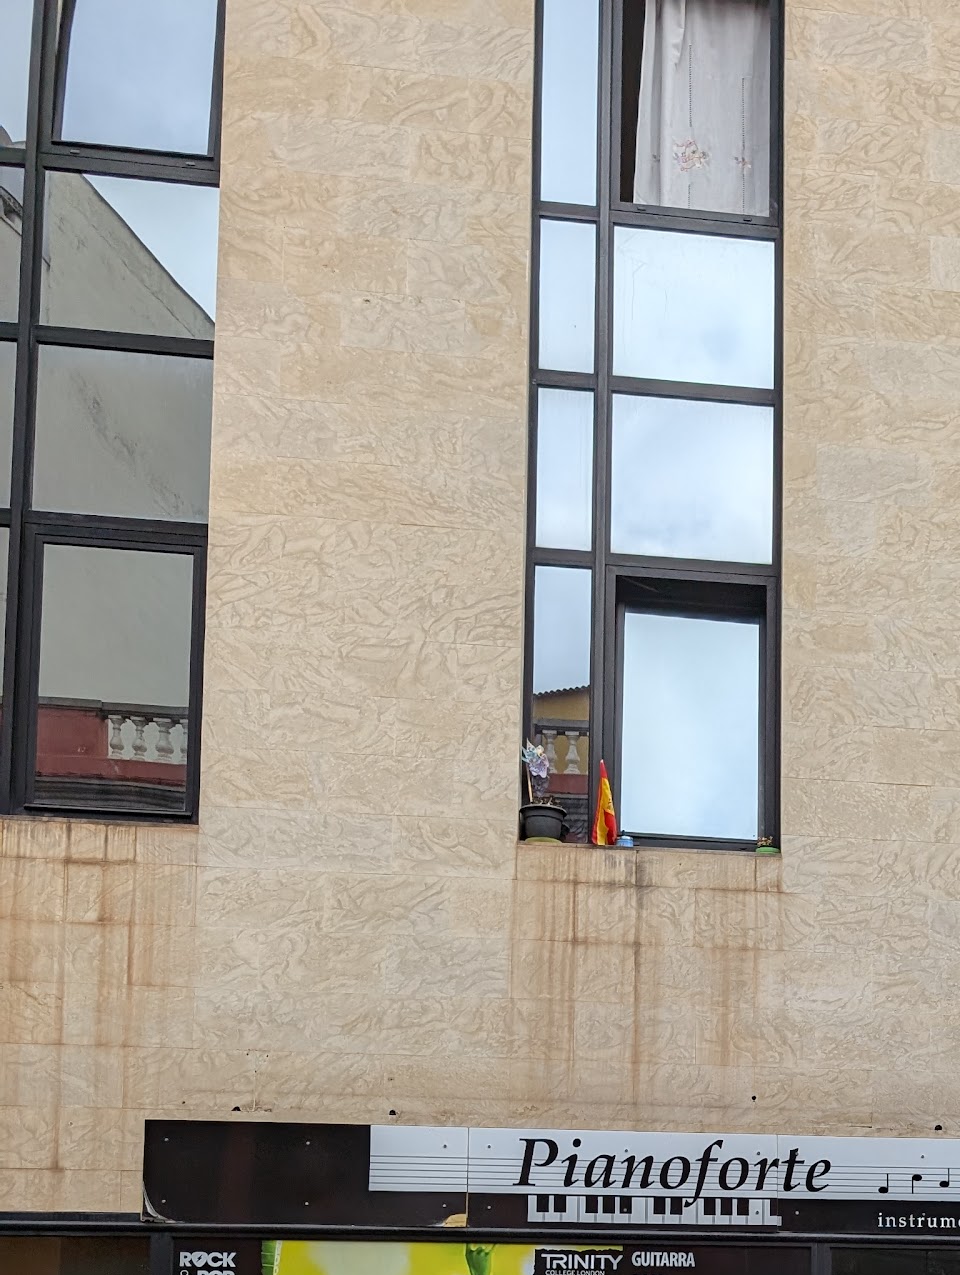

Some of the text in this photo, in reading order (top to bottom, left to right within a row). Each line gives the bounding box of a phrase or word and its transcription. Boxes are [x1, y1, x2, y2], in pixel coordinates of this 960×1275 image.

[512, 1138, 832, 1208] Pianoforte
[179, 1251, 237, 1268] ROCK
[540, 1253, 624, 1270] TRINITY
[631, 1251, 696, 1268] GUITARRA
